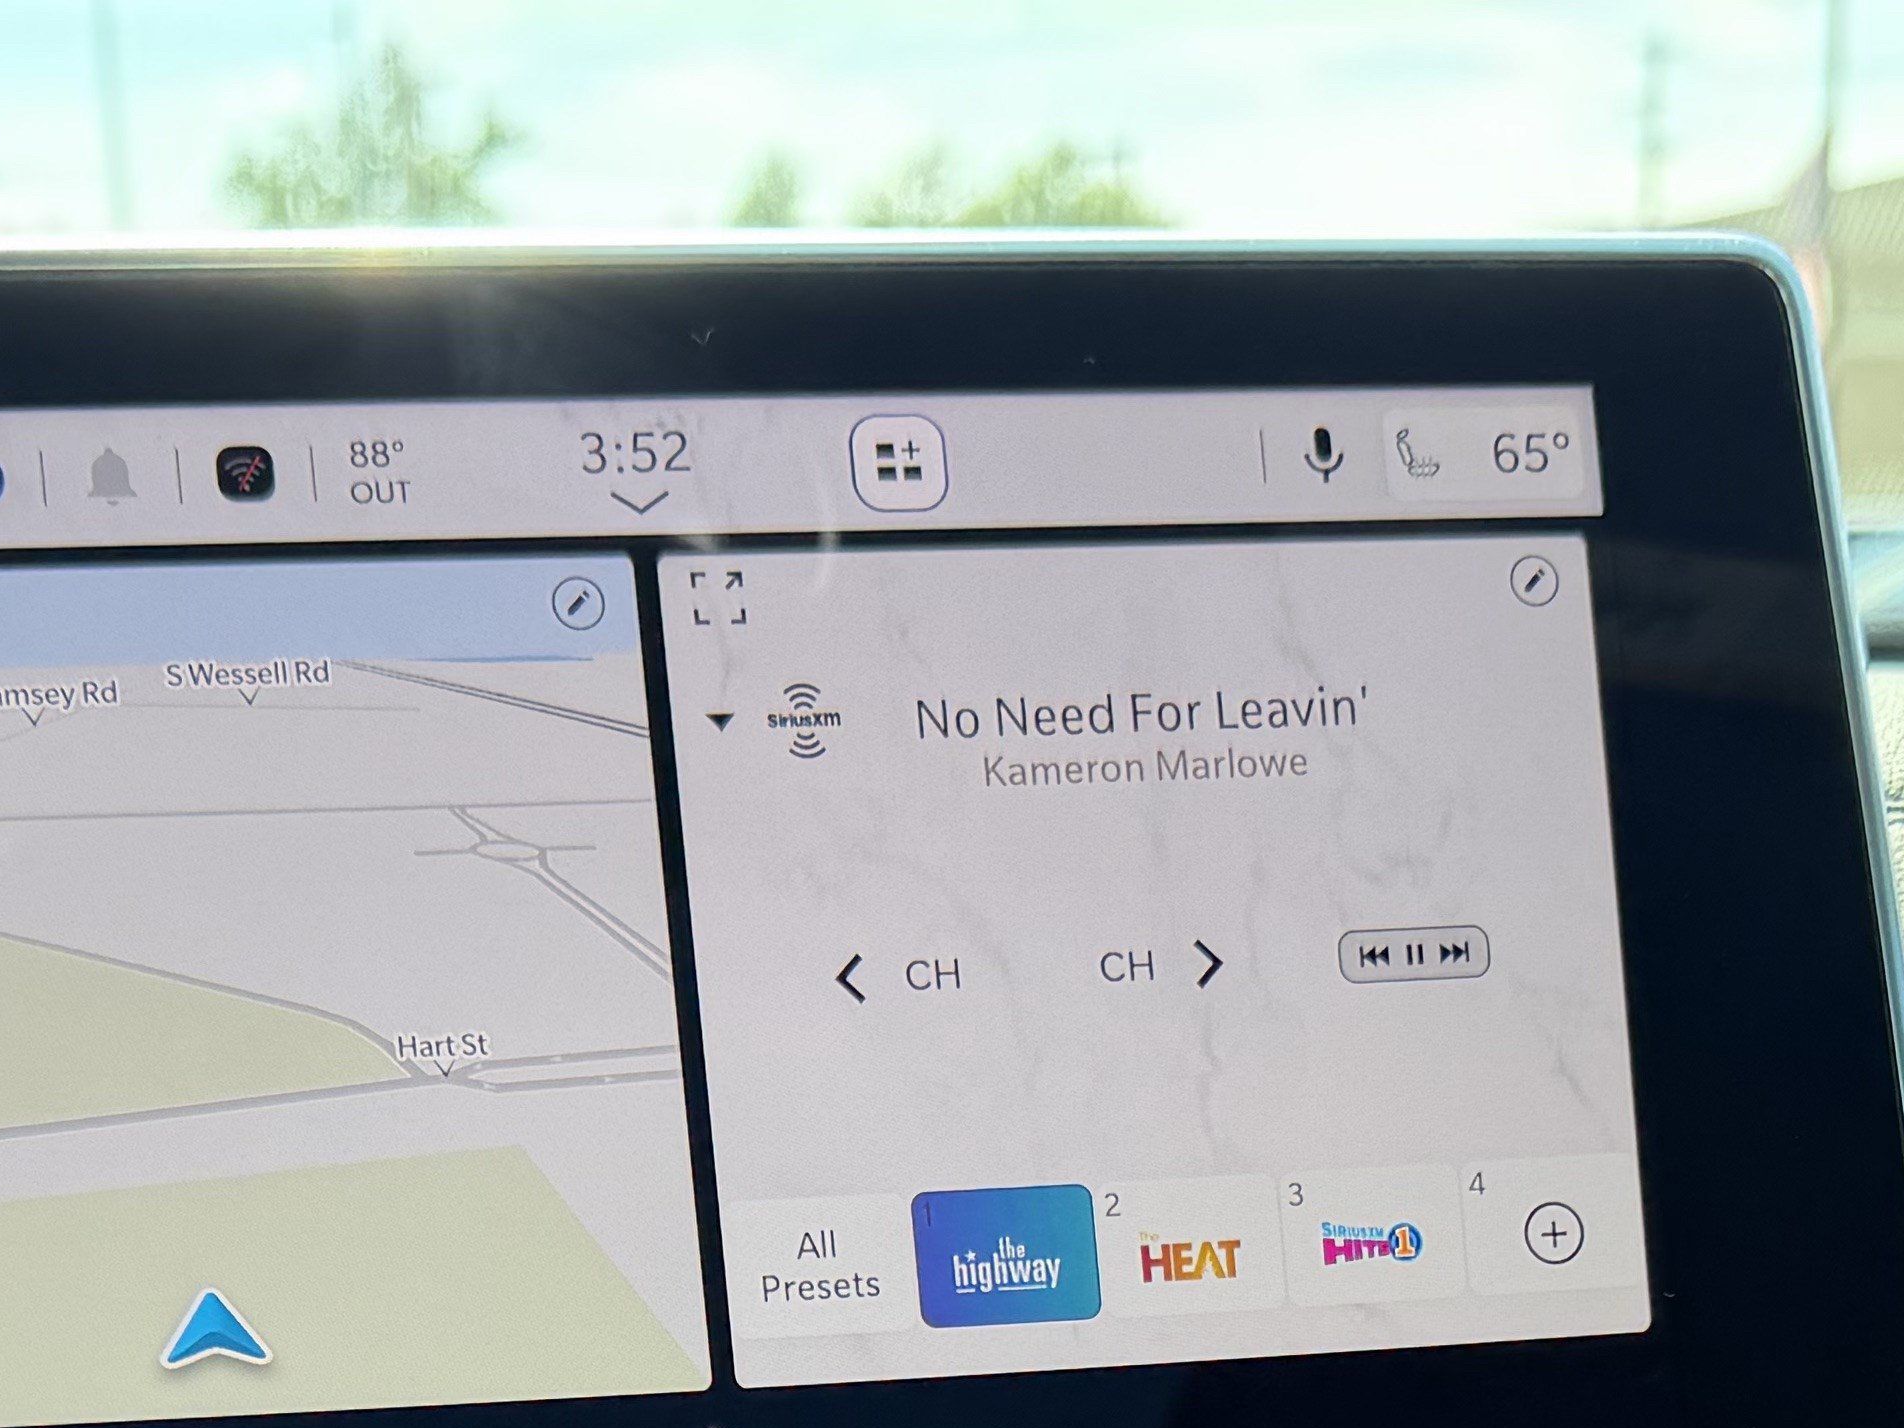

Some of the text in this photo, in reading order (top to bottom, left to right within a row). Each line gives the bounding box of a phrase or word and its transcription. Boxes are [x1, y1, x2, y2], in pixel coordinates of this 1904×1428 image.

[349, 438, 404, 468] 88°
[580, 430, 692, 474] 3:52
[1493, 430, 1569, 474] 65°
[350, 479, 410, 505] OUT
[167, 658, 331, 688] S Wessell Rd
[82, 678, 117, 704] Rd
[917, 686, 1368, 739] No Need For Leavin'
[983, 748, 1308, 788] Kameron Marlowe
[906, 959, 961, 992] CH
[1100, 951, 1155, 984] CH
[398, 1033, 487, 1058] Hart St
[1287, 1182, 1305, 1206] 3
[1468, 1172, 1486, 1197] 4
[1105, 1193, 1122, 1218] 2
[798, 1230, 836, 1260] All
[998, 1236, 1025, 1258] the
[953, 1249, 1061, 1292] highway
[1141, 1239, 1242, 1283] HEAT
[762, 1271, 880, 1302] Presets
